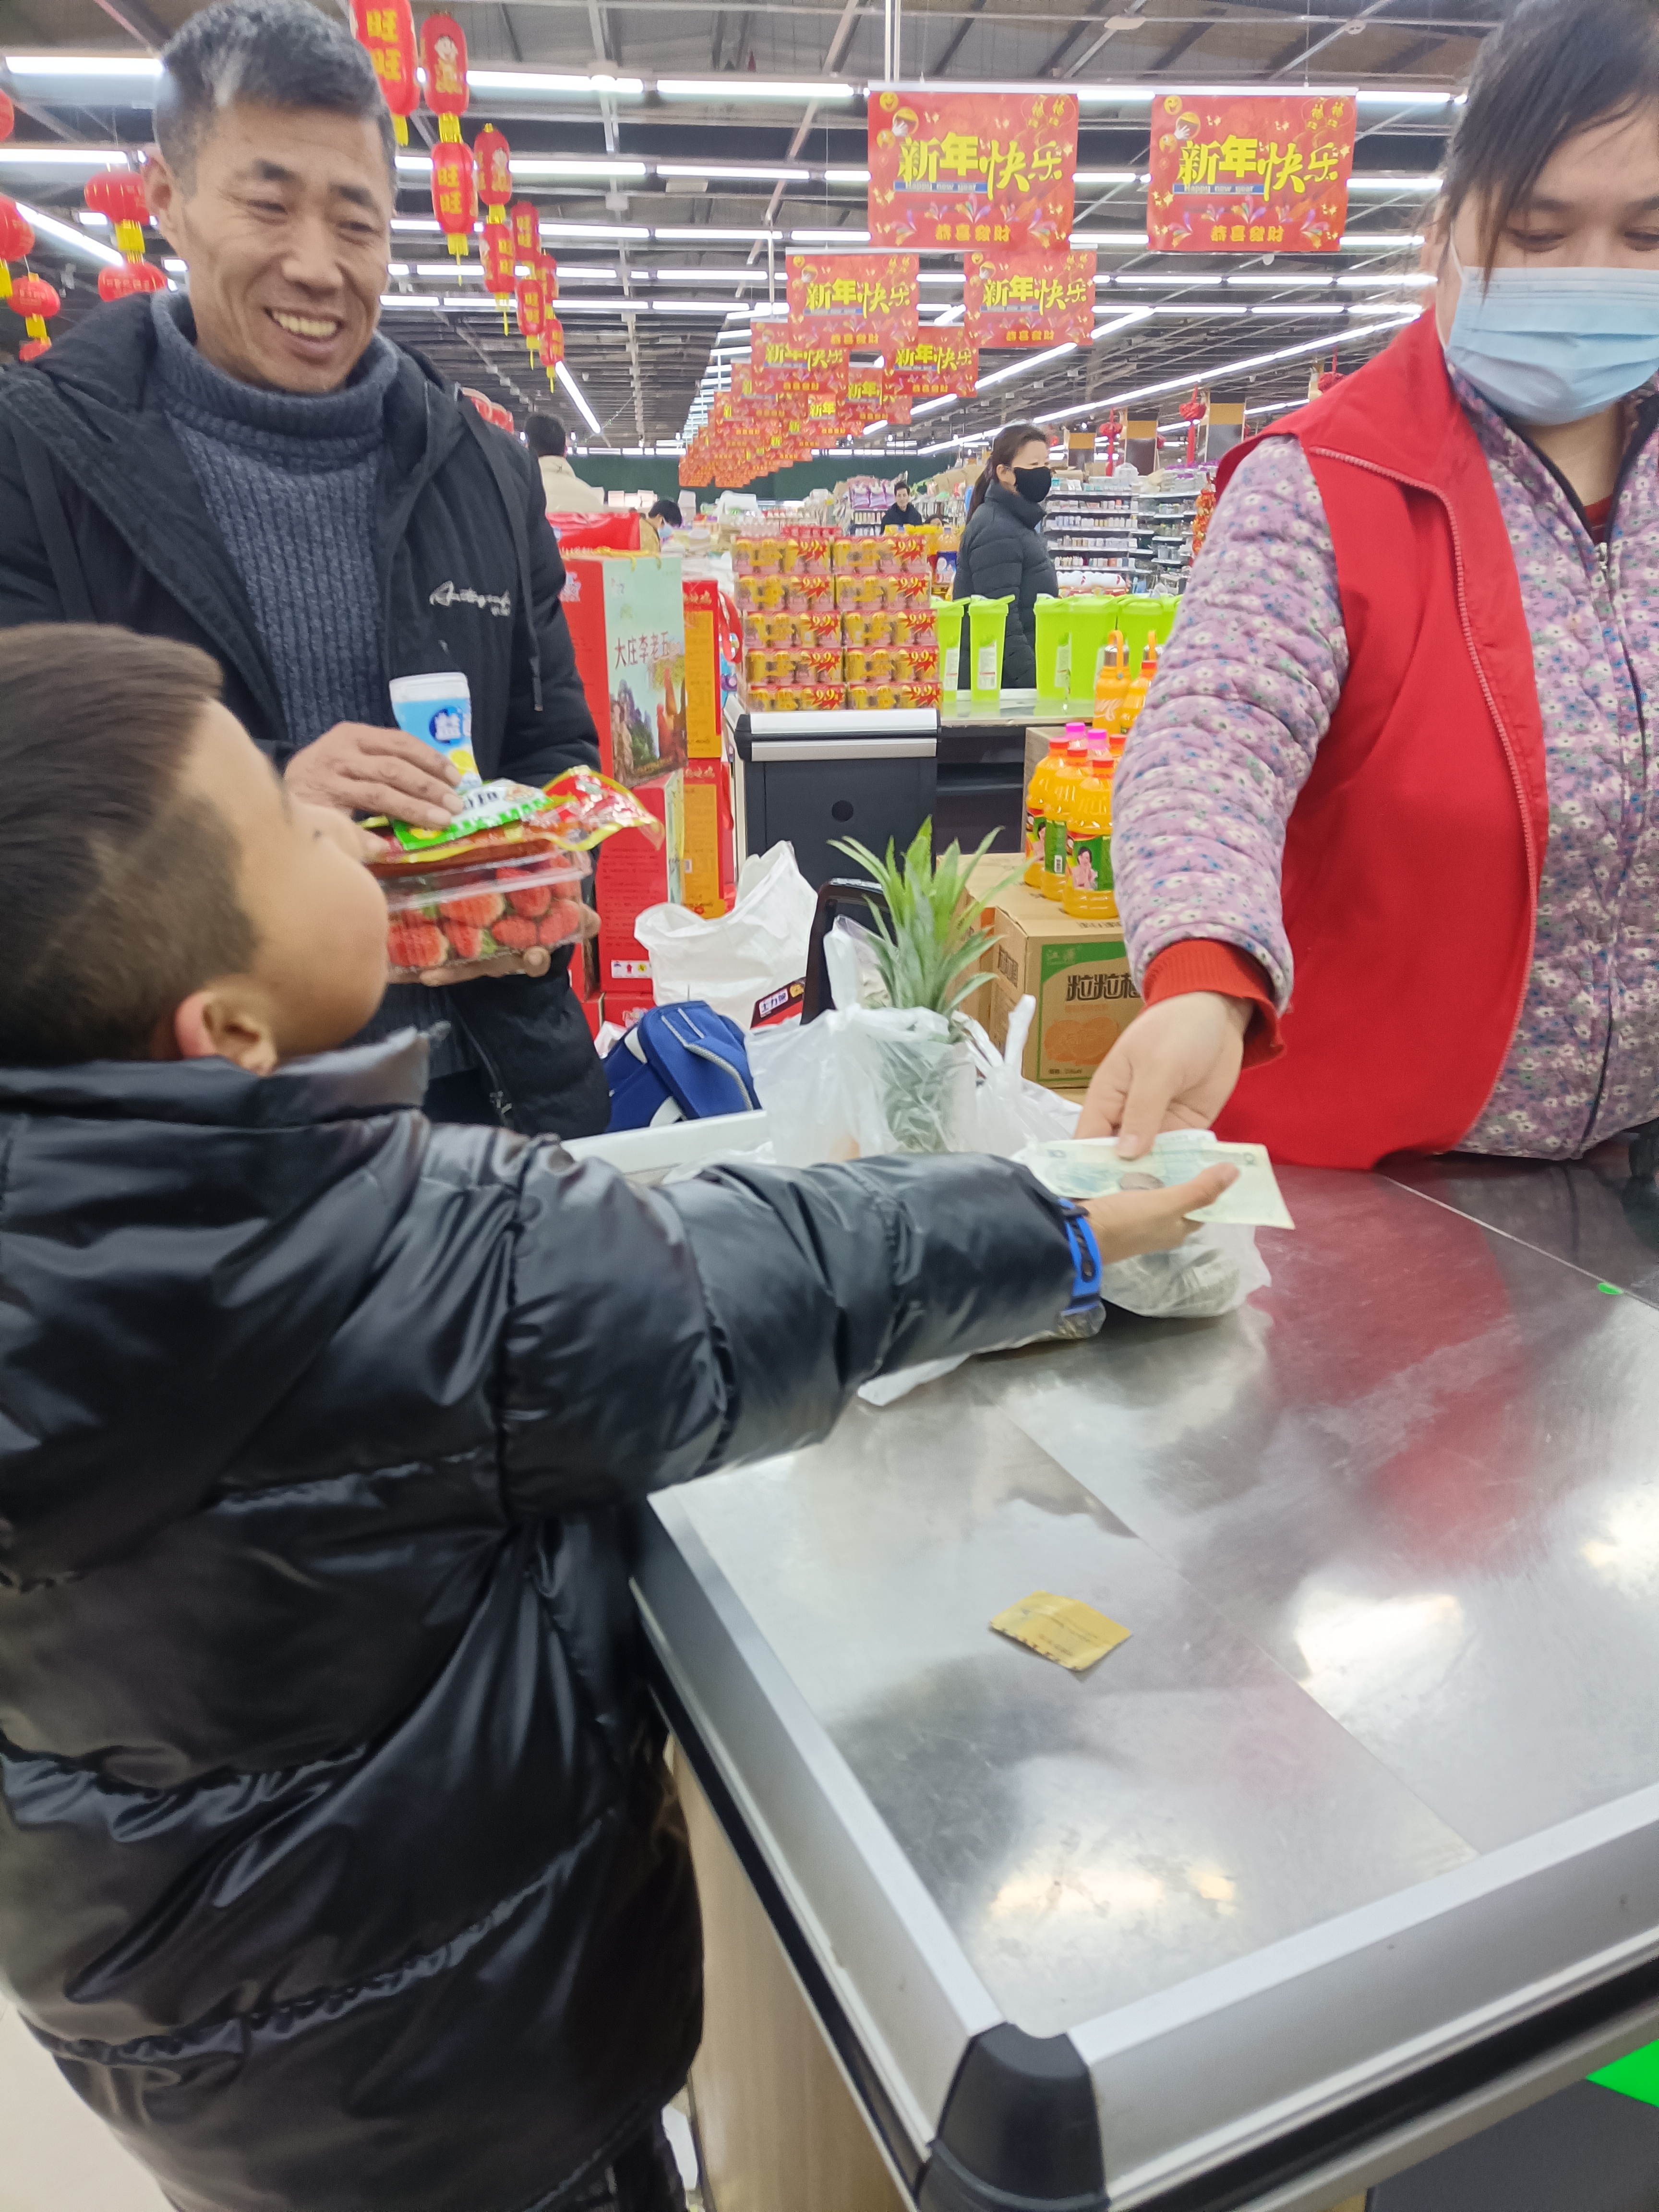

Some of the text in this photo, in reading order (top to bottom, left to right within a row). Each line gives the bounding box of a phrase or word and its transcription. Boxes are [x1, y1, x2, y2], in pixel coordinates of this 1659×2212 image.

[897, 132, 1063, 201] 新年快乐
[1178, 134, 1338, 202] 新年快乐
[805, 277, 911, 319] 新年快乐
[982, 275, 1086, 316] 新年快乐
[895, 343, 973, 374] 新年快乐
